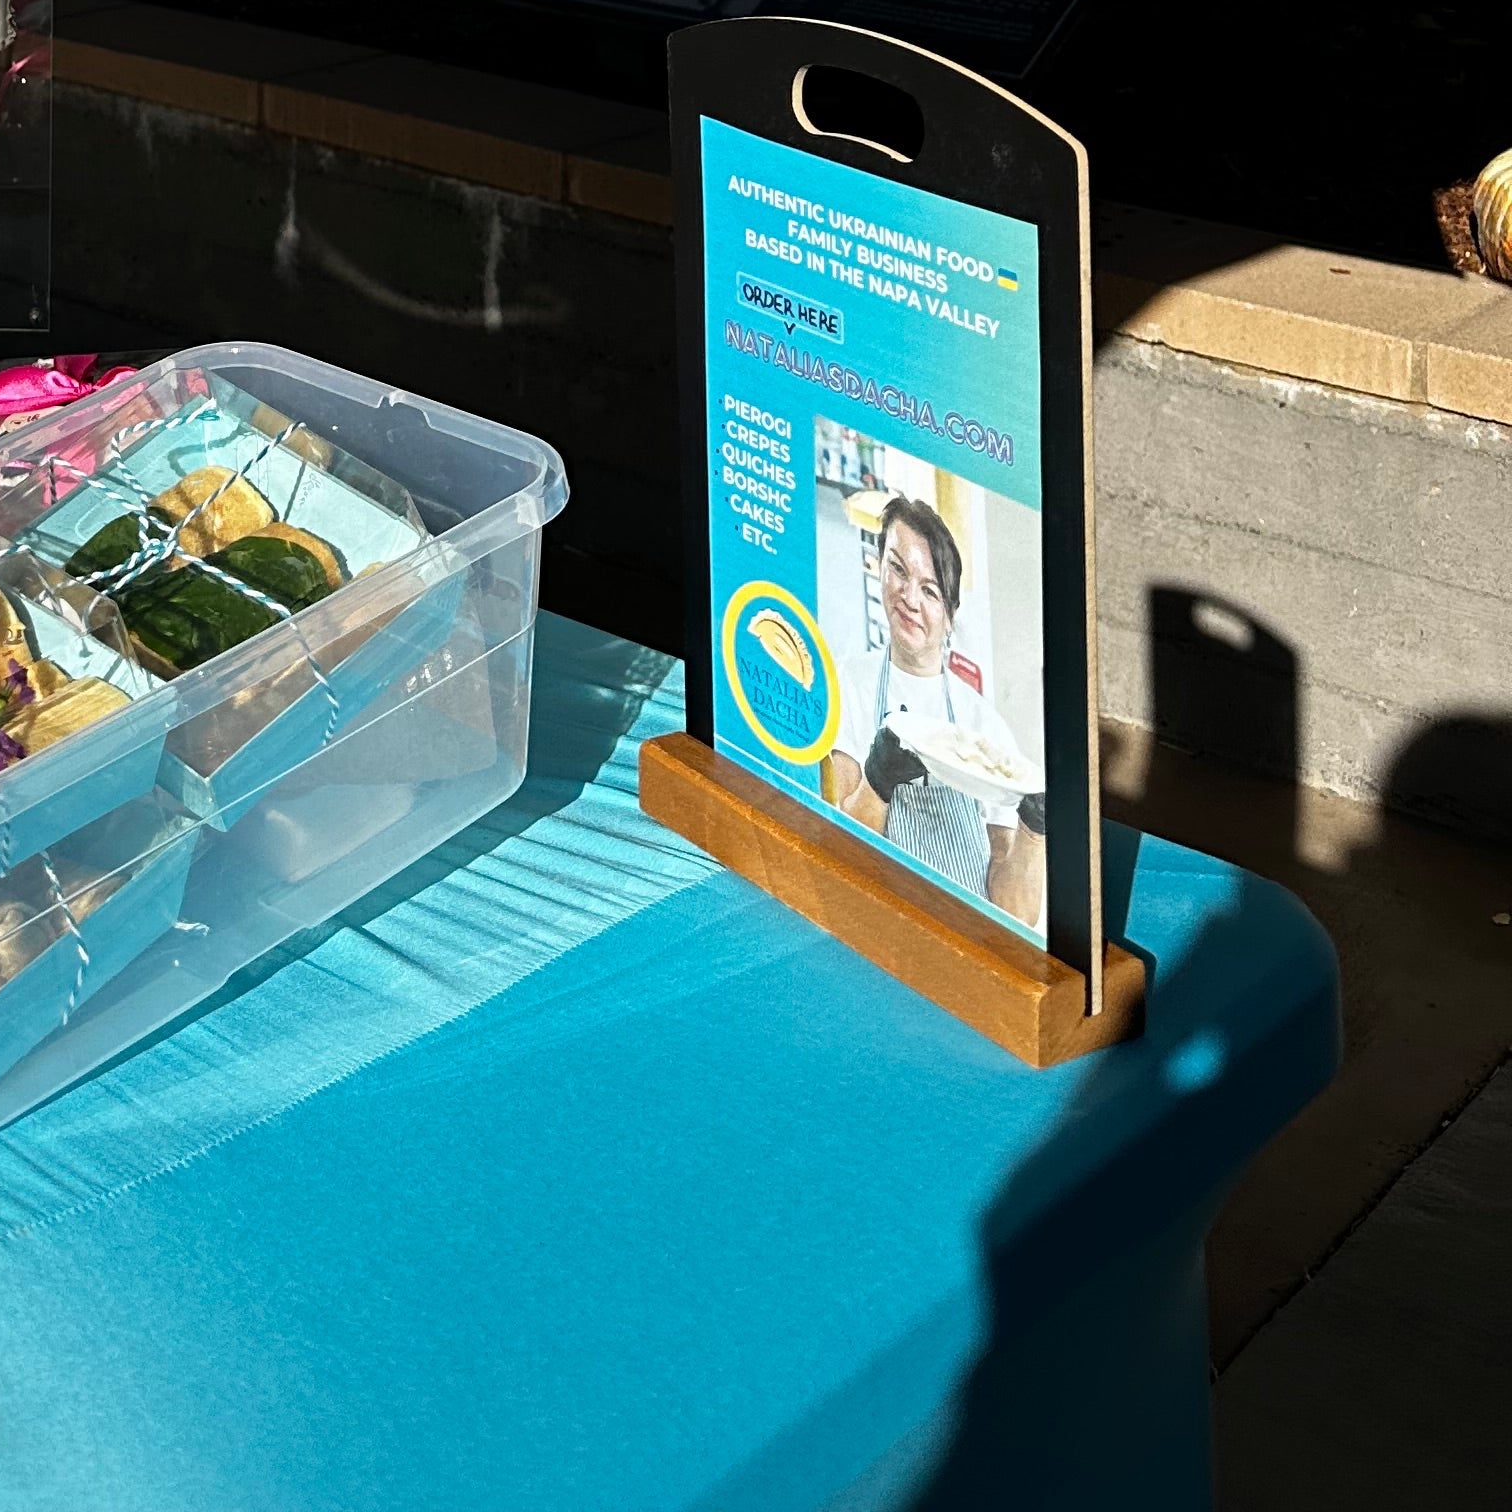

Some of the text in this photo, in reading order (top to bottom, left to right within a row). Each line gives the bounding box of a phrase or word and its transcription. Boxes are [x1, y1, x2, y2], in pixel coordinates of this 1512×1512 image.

[728, 175, 994, 282] AUTHENTIC UKRAINIAN FOOD
[788, 219, 948, 293] FAMILY BUSINESS
[745, 228, 1000, 338] BASED IN THE NAPA VALLEY
[743, 283, 838, 334] ORDER HERE
[725, 319, 1013, 466] NATALIASDACHA.COM
[724, 394, 792, 440] PIEROGI
[726, 420, 791, 463] CREPES
[722, 442, 796, 490] QUICHES
[723, 465, 792, 513] BORSHC
[730, 494, 785, 534] CAKES
[742, 523, 778, 555] ETC.
[740, 656, 823, 718] NATALIA'S
[753, 687, 811, 733] DACHA
